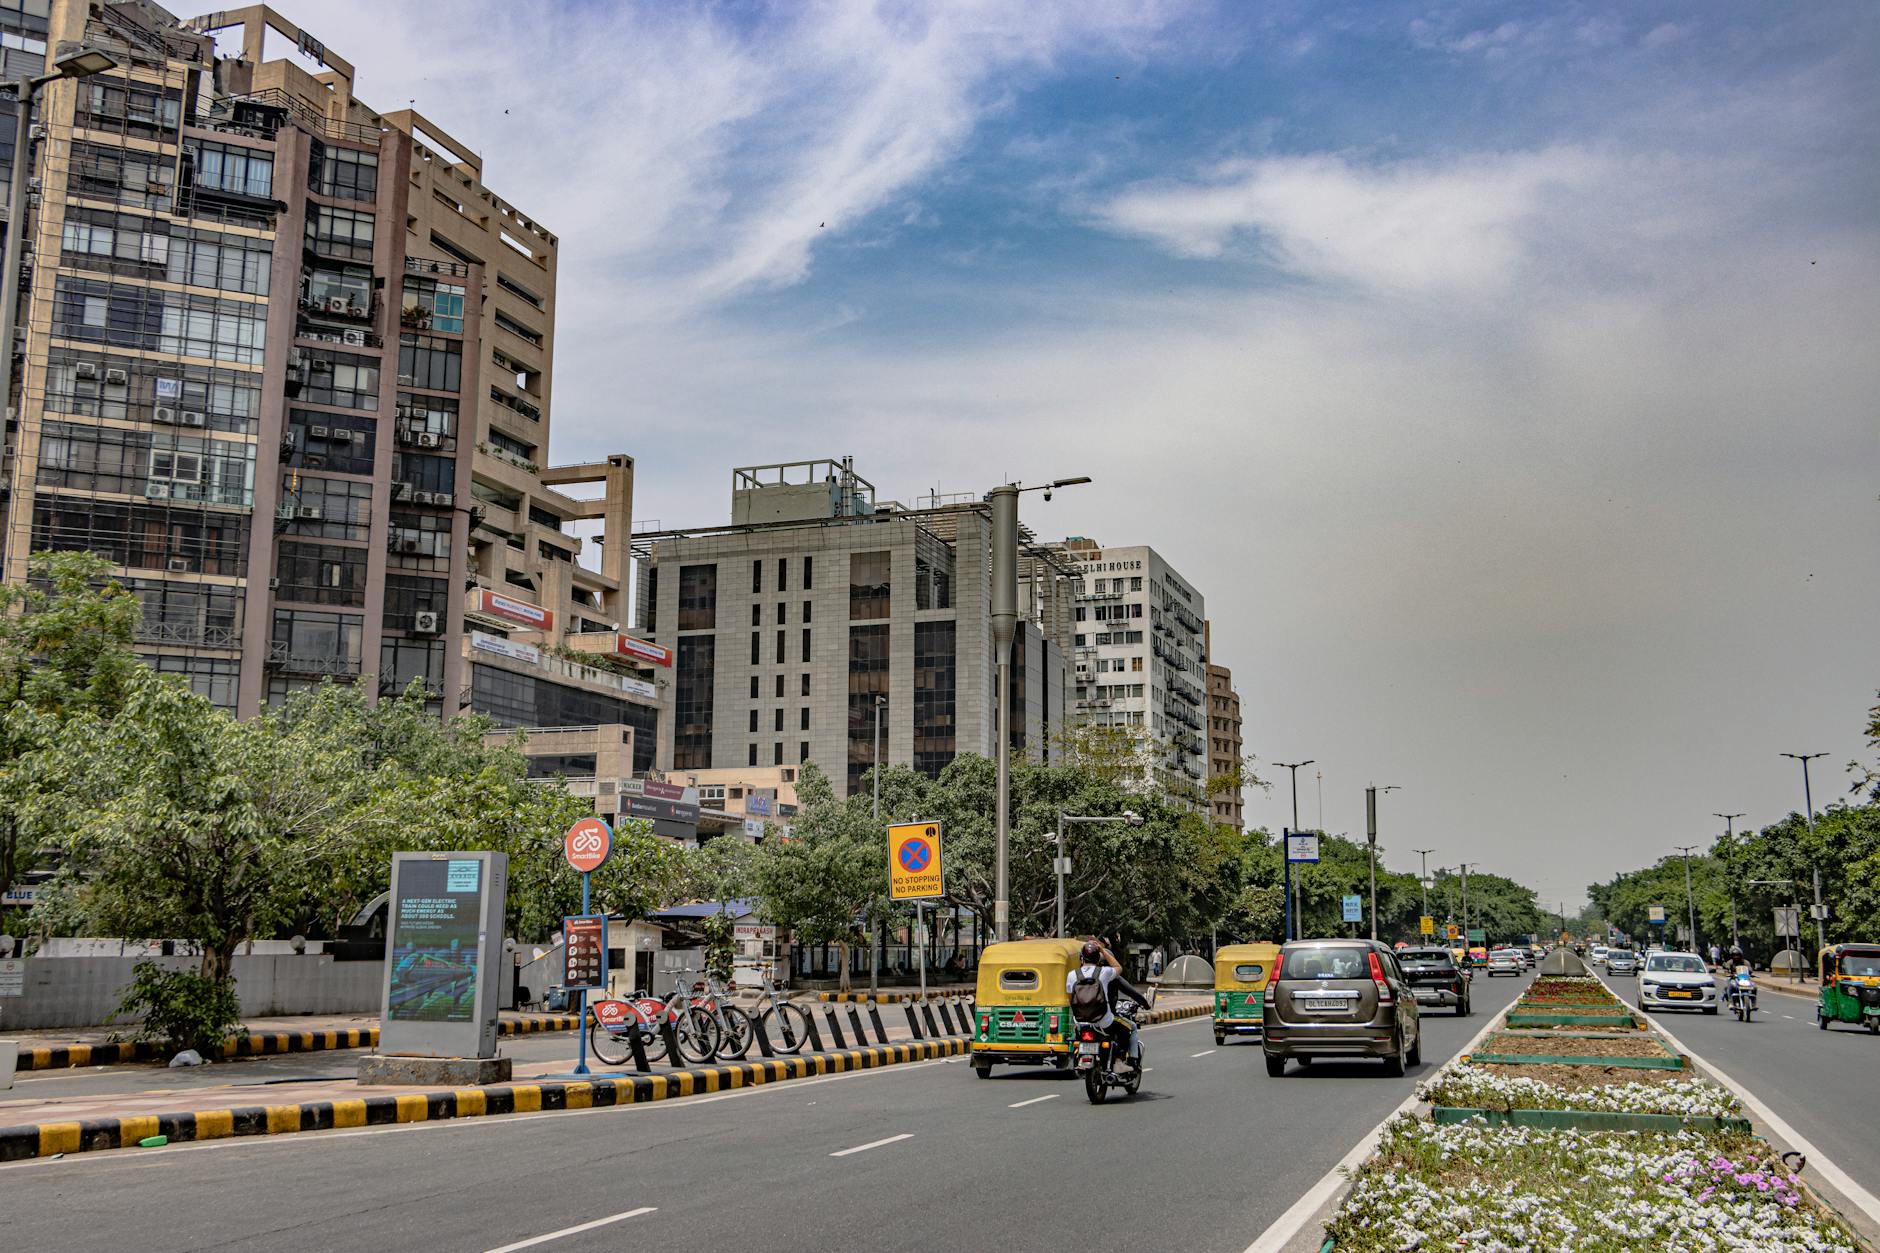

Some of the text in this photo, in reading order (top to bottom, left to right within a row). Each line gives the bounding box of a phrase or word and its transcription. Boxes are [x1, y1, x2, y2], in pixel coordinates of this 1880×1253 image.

[1109, 561, 1142, 572] HOUSE
[905, 875, 939, 884] STOPPING
[908, 884, 938, 892] PARKING
[6, 891, 33, 899] BLUE
